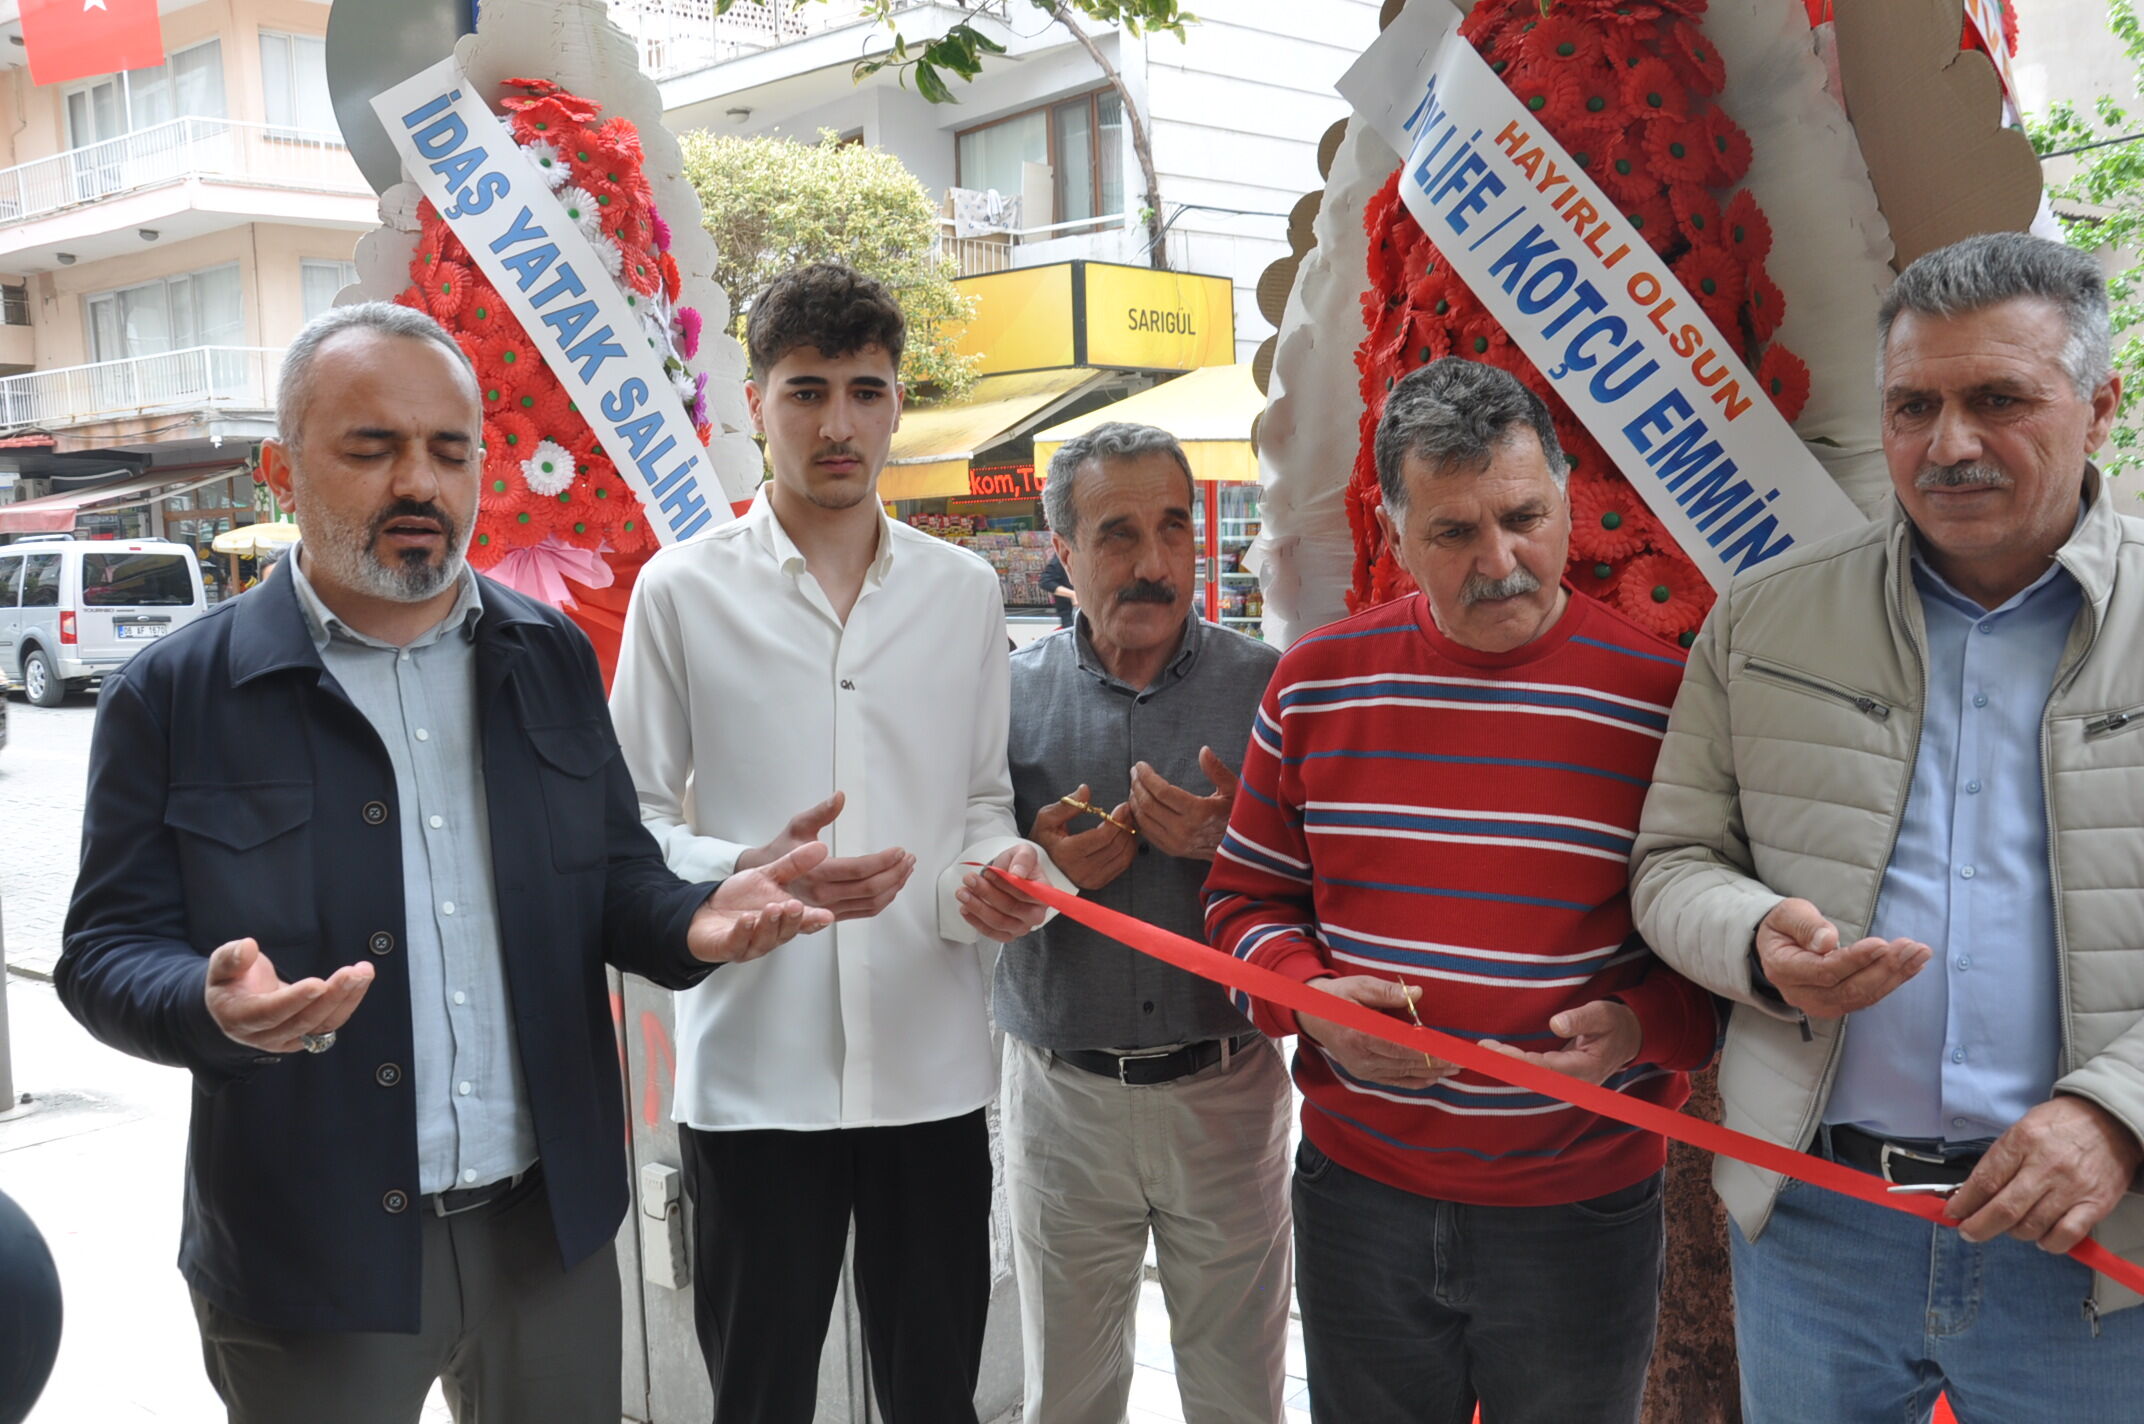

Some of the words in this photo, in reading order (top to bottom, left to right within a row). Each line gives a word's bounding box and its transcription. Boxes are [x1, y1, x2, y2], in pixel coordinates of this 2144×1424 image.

[402, 88, 510, 220] İDAŞ
[489, 206, 628, 385] YATAK
[1128, 307, 1196, 335] SARIGÜL
[1414, 128, 1507, 236] LİFE
[1487, 223, 1661, 404] KOTÇU
[1622, 388, 1795, 576] EMMİN
[1494, 119, 1631, 270] HAYIRLI
[1625, 271, 1753, 422] OLSUN
